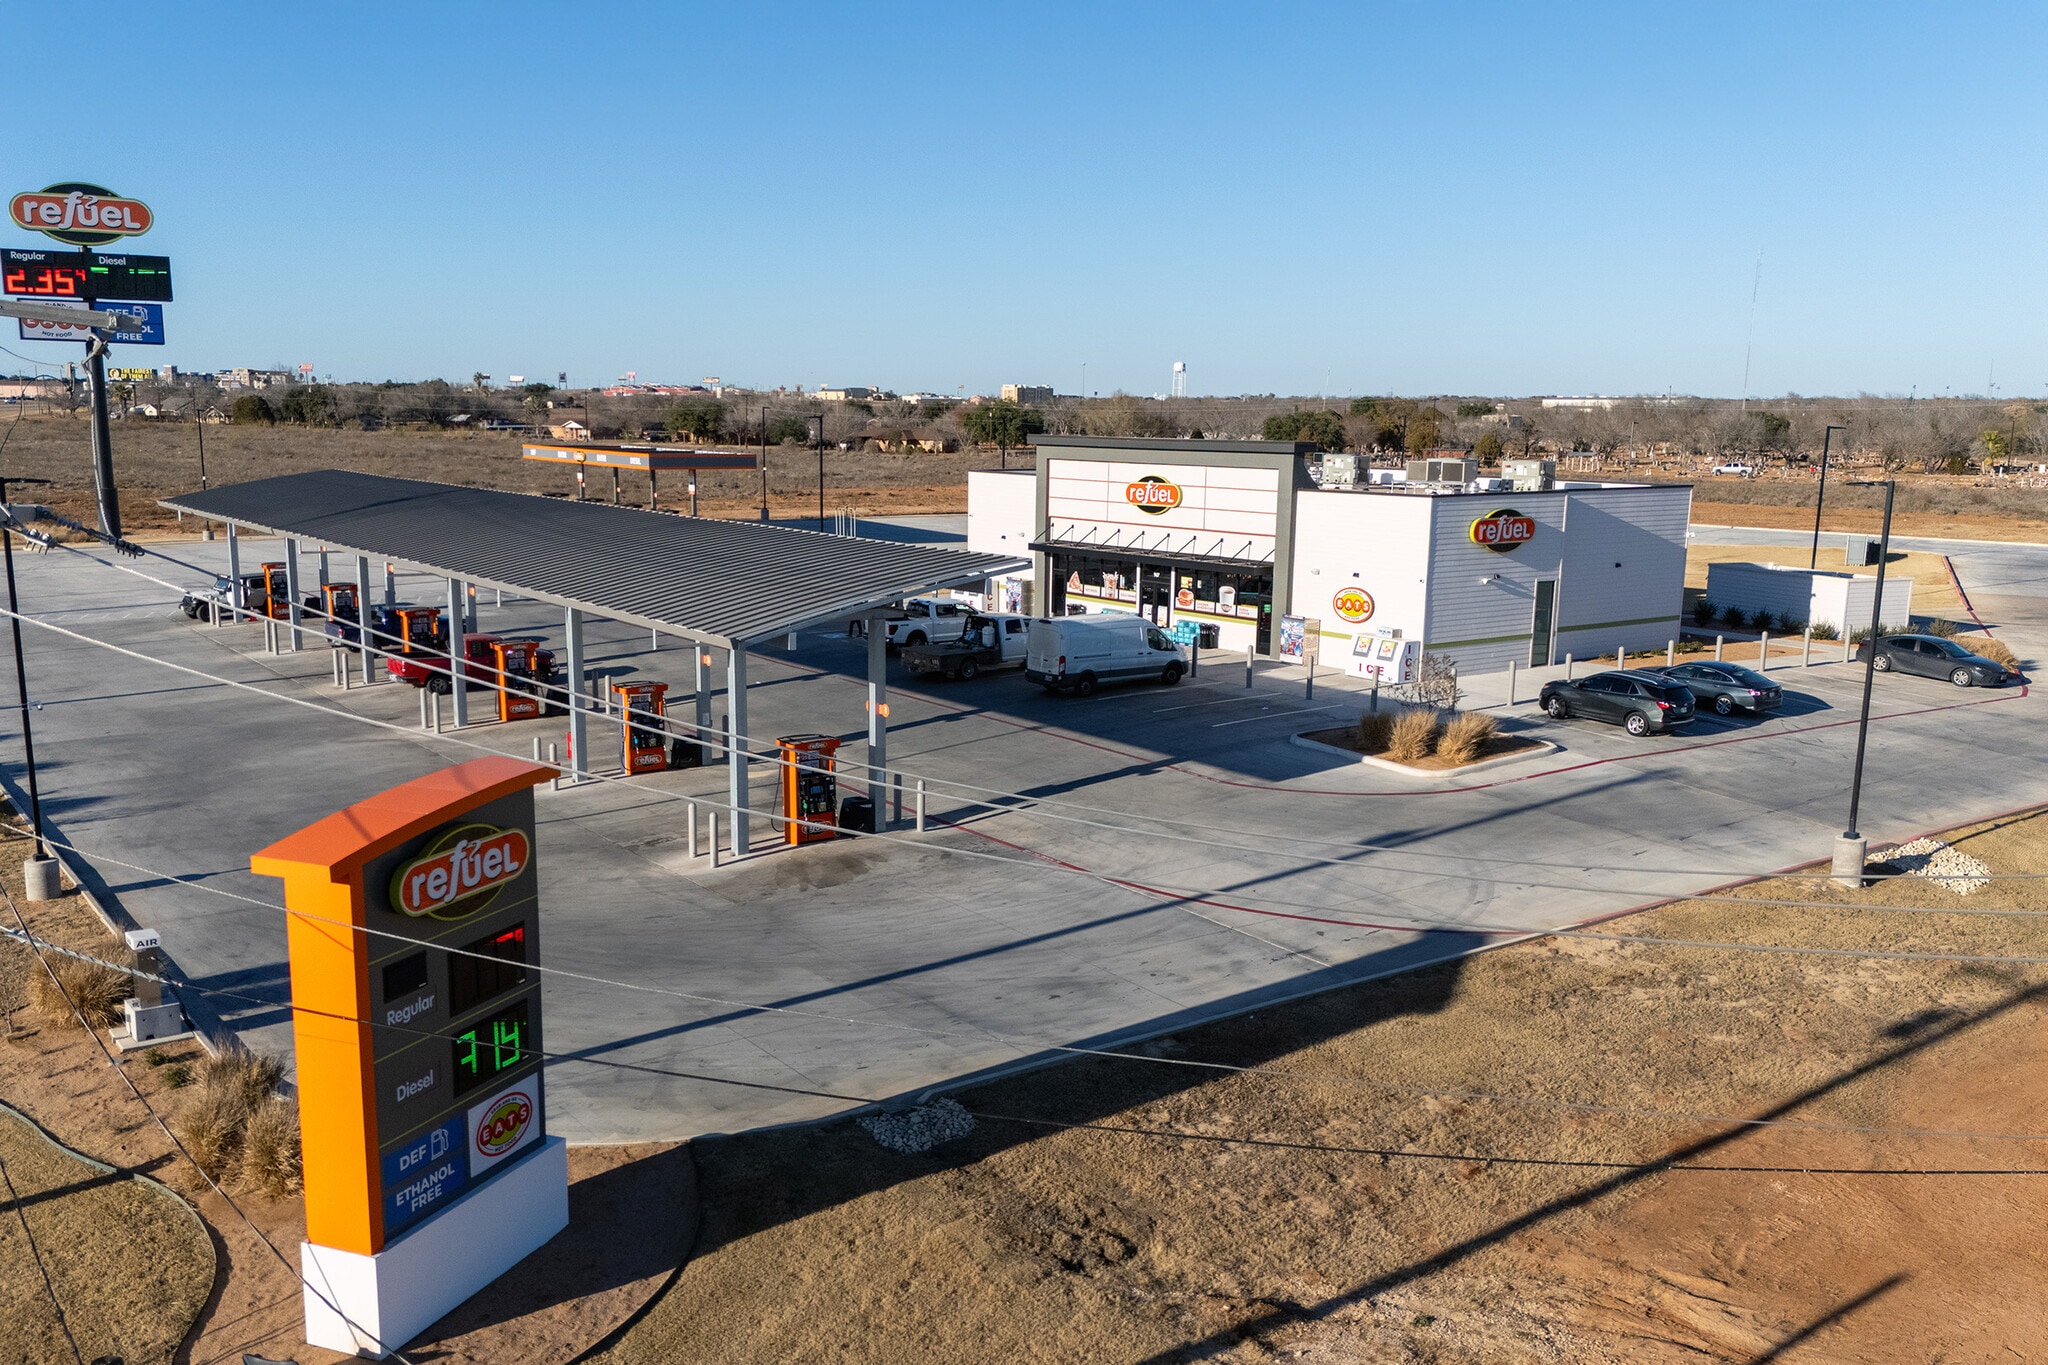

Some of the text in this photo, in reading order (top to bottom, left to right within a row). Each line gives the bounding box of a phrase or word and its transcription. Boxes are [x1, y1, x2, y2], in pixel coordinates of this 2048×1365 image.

[10, 251, 46, 262] Regular
[98, 256, 127, 266] Diesel
[116, 332, 143, 341] FREE
[1336, 600, 1370, 612] EATS
[1358, 662, 1385, 676] ICE
[1404, 644, 1413, 681] ICE
[136, 938, 158, 948] AIR
[387, 995, 435, 1026] Regular
[397, 1070, 434, 1102] Diesel
[482, 1106, 527, 1139] EATS
[399, 1143, 427, 1171] DEF
[396, 1163, 456, 1207] ETHANOL
[411, 1183, 443, 1213] FREE
